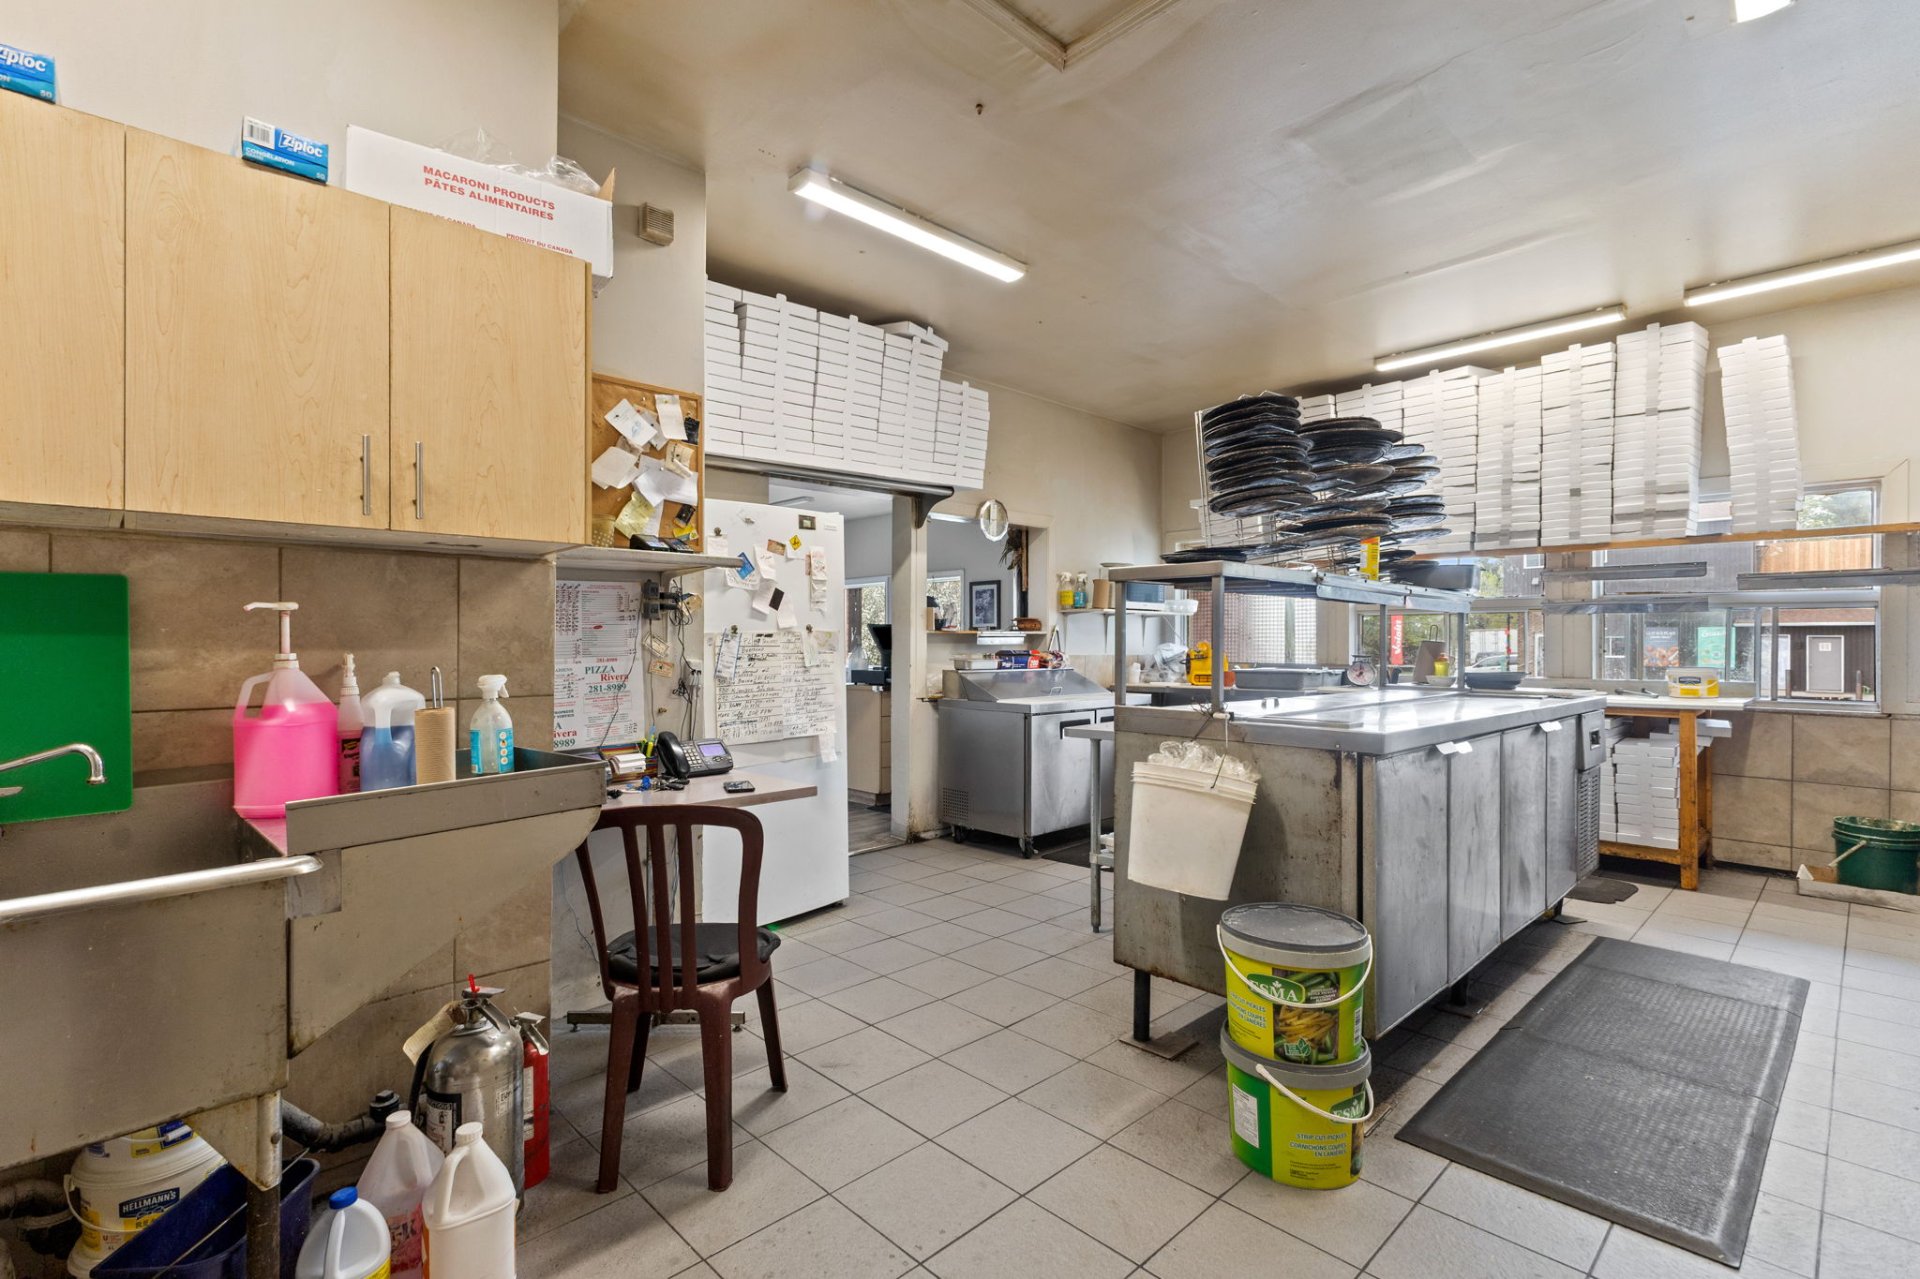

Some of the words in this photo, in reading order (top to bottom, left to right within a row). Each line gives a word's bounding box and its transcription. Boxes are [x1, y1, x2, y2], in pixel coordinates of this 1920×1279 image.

[0, 46, 46, 72] iploc
[282, 133, 323, 158] Ziploc
[423, 165, 490, 191] MACARONI
[493, 186, 556, 210] PRODUCTS
[424, 177, 465, 196] PÂTES
[469, 190, 554, 221] ALIMENTAIRES
[506, 232, 536, 245] PRODUIT
[547, 243, 574, 255] CANADA
[585, 665, 615, 674] PIZZA
[588, 683, 627, 693] 281-8989
[554, 729, 577, 739] ivera
[122, 1190, 177, 1213] HELLMANN'S
